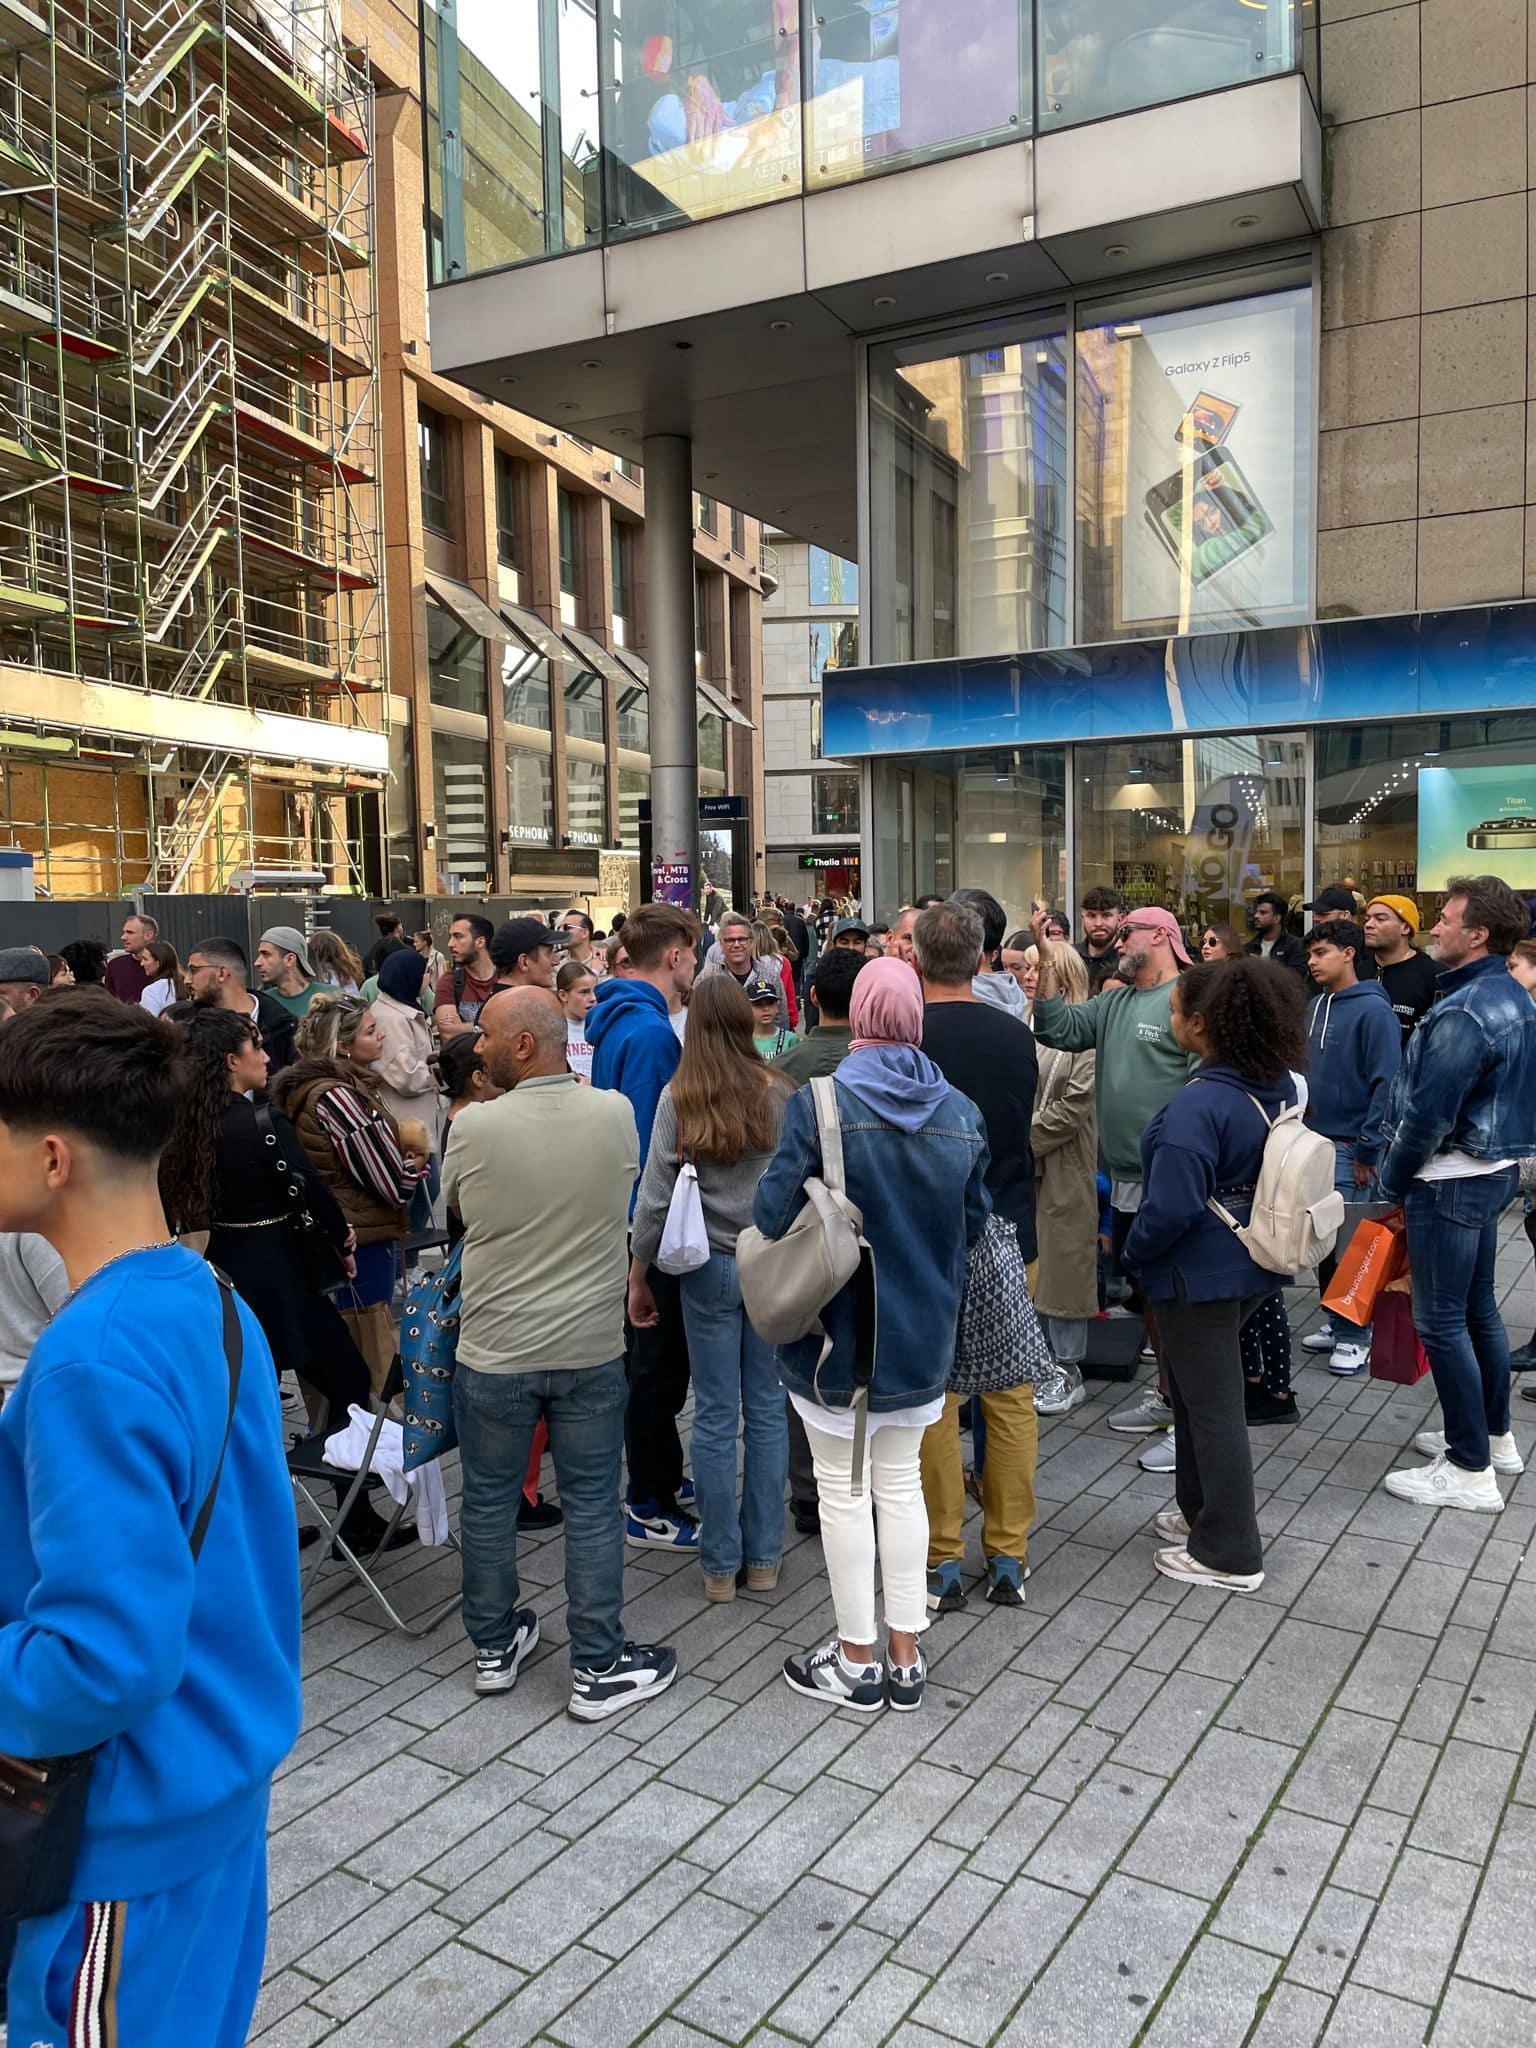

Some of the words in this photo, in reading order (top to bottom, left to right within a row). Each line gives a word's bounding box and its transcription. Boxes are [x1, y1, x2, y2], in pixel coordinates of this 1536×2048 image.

[1165, 361, 1210, 376] Galaxy
[1212, 357, 1220, 368] Z
[1221, 352, 1251, 367] Flip5
[509, 825, 549, 841] SEPHORA
[813, 857, 840, 866] Thalia
[670, 866, 689, 874] MTB
[657, 875, 664, 884] &
[664, 875, 689, 884] Cross
[1342, 1237, 1381, 1304] breuninger.com
